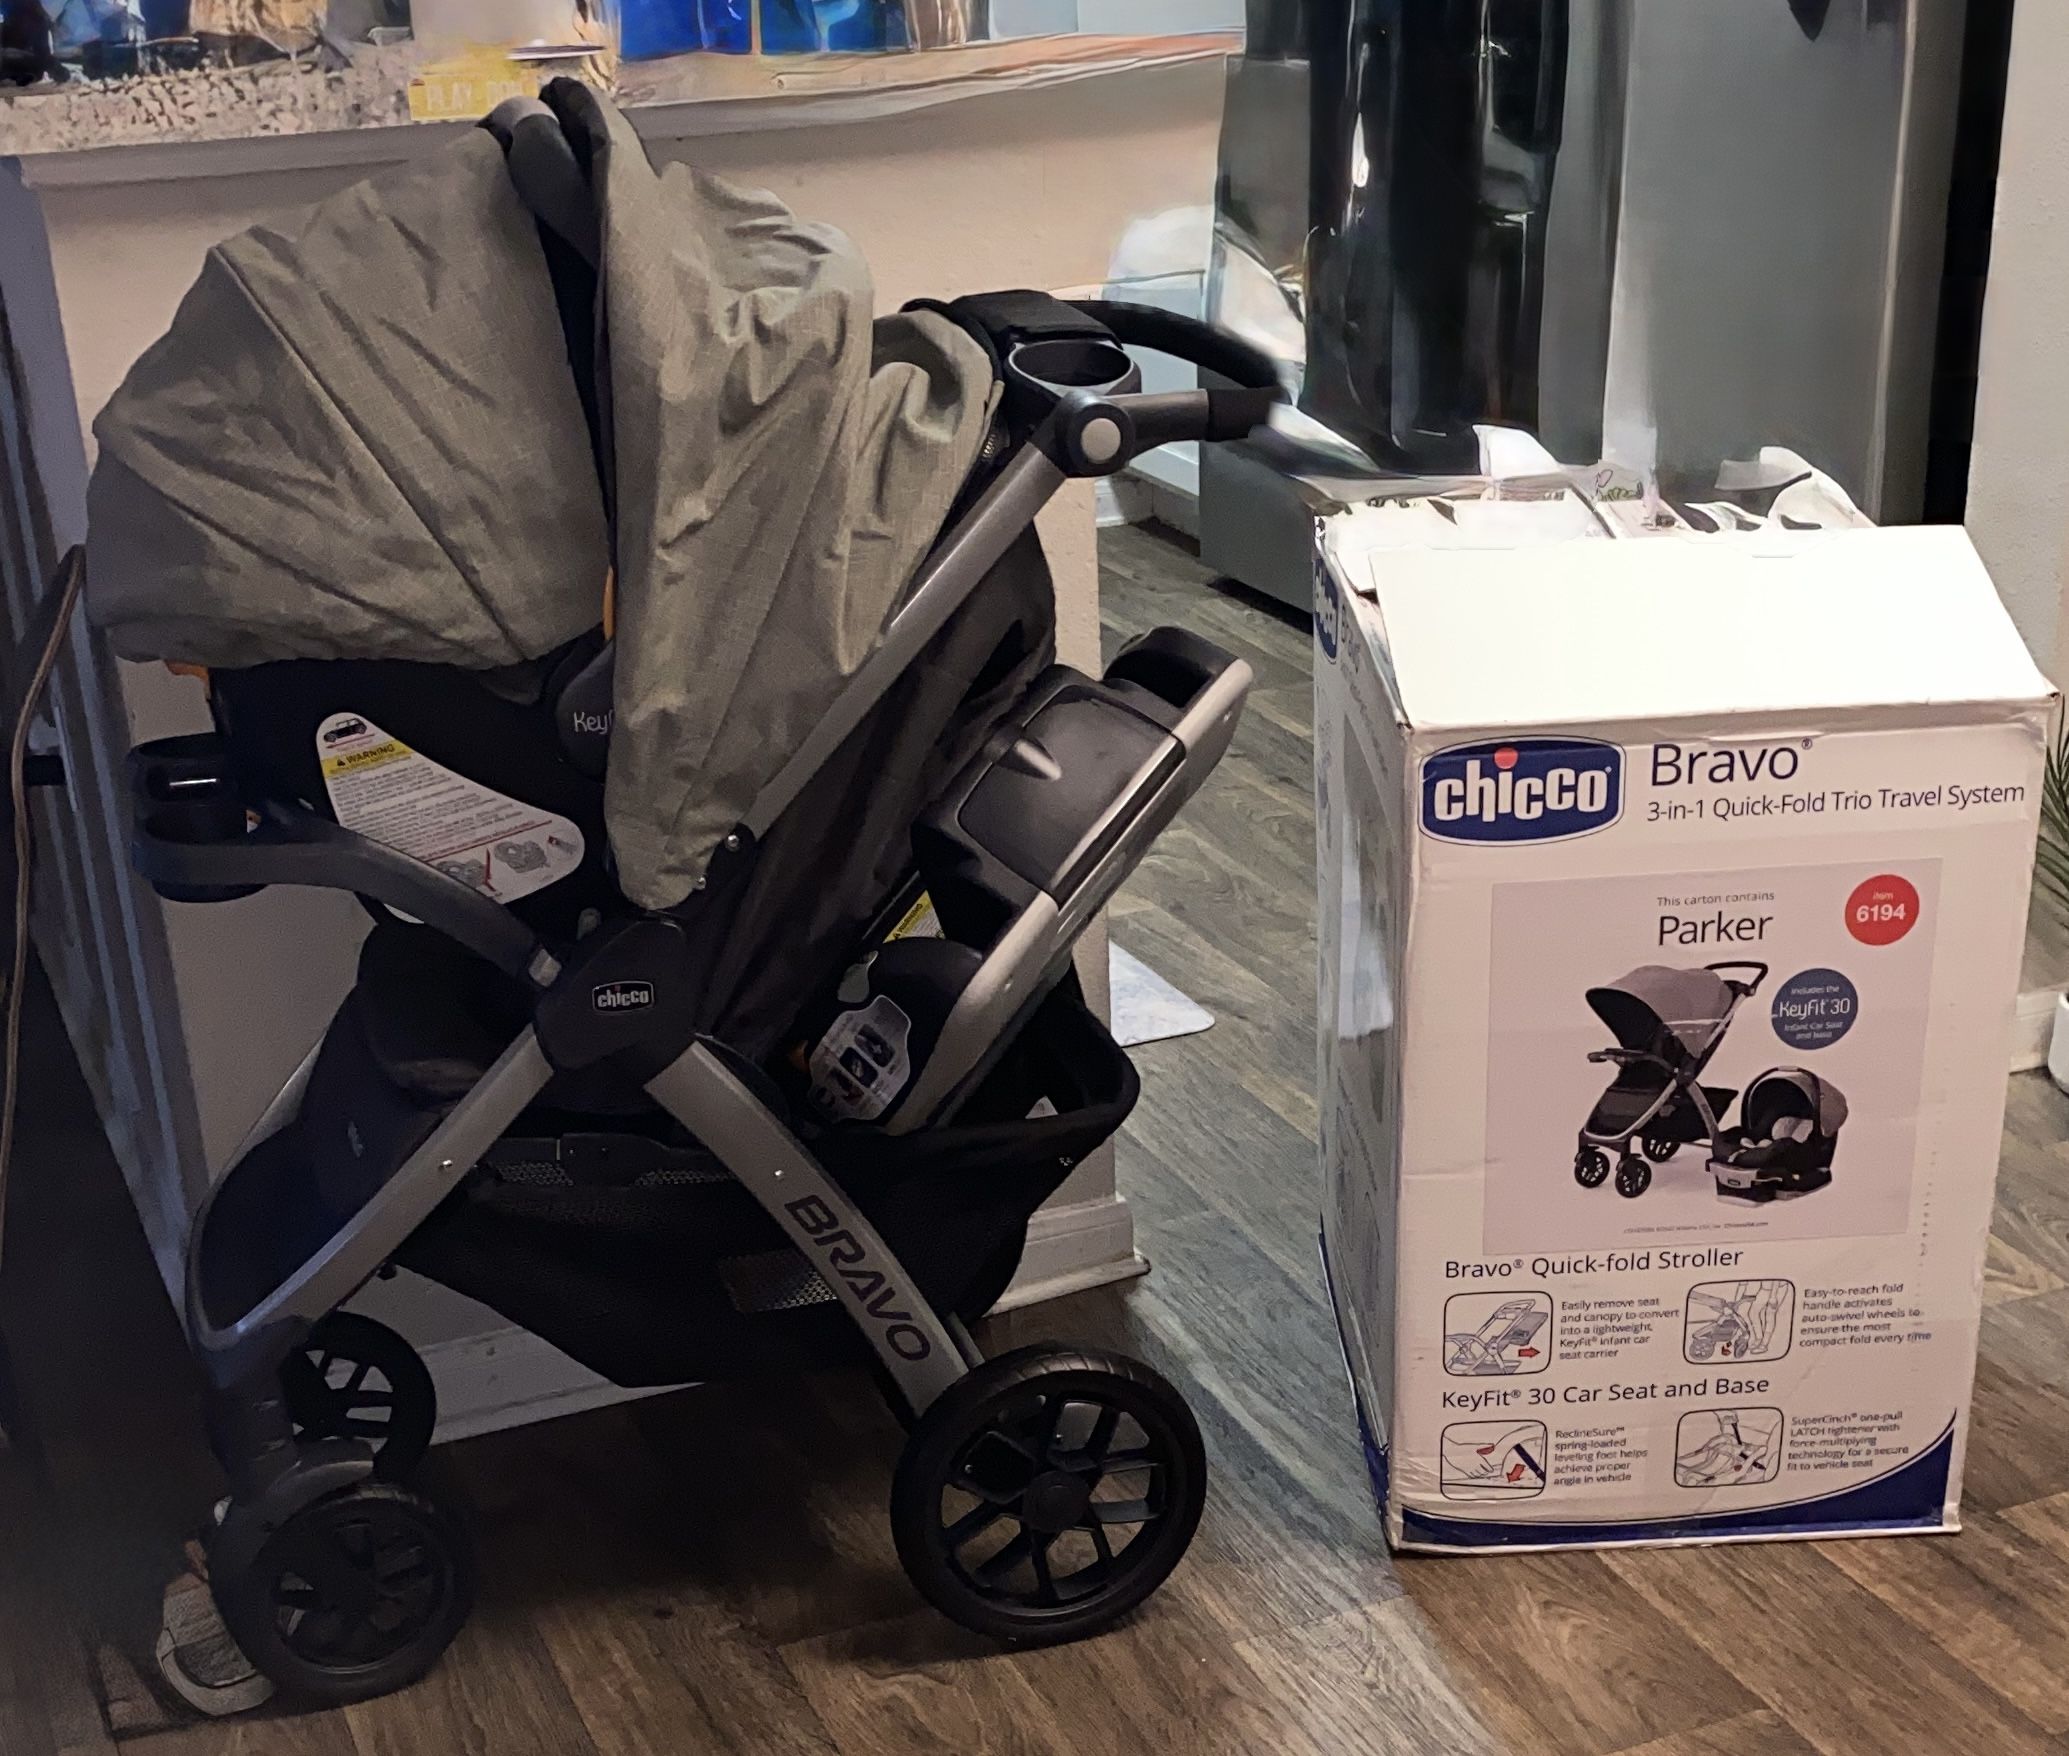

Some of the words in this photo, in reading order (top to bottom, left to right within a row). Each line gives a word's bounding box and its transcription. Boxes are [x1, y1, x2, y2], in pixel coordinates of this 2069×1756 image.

[1434, 747, 1612, 822] chicco
[1647, 801, 1704, 822] 3-in-1
[1713, 792, 1825, 821] Quick-Fold
[1831, 790, 1872, 811] Trio
[1878, 785, 1942, 808] Travel
[1948, 784, 2025, 810] System
[1656, 896, 1680, 907] This
[1684, 894, 1722, 905] carton
[1725, 891, 1776, 902] contains
[1855, 904, 1906, 923] 6194
[1658, 911, 1774, 946] Parker
[597, 984, 649, 1007] chicco
[1830, 997, 1851, 1015] 30
[1531, 1251, 1650, 1278] Quick-fold
[1657, 1247, 1744, 1270] Stroller
[784, 1195, 931, 1361] BRAVO
[1804, 1286, 1880, 1299] Easy-to-reach
[1882, 1283, 1904, 1294] fold
[1561, 1300, 1592, 1312] Easily
[1593, 1299, 1635, 1309] remove
[1638, 1298, 1660, 1308] seat
[1803, 1299, 1842, 1310] handle
[1843, 1297, 1894, 1309] activates
[1560, 1313, 1582, 1323] and
[1584, 1312, 1623, 1323] canopy
[1625, 1310, 1637, 1319] to
[1639, 1309, 1680, 1319] convert
[1866, 1308, 1906, 1319] wheels
[1908, 1308, 1921, 1317] to
[1560, 1326, 1581, 1335] into
[1583, 1326, 1591, 1334] a
[1800, 1324, 1839, 1336] ensure
[1841, 1323, 1860, 1333] the
[1862, 1322, 1892, 1332] most
[1633, 1334, 1651, 1345] car
[1799, 1336, 1847, 1348] compact
[1849, 1334, 1872, 1345] fold
[1874, 1333, 1905, 1345] every
[1906, 1331, 1932, 1342] time
[1559, 1350, 1581, 1360] seat
[1583, 1348, 1620, 1358] carrier
[1528, 1386, 1556, 1405] 30
[1563, 1386, 1603, 1404] Car
[1608, 1383, 1658, 1401] Seat
[1664, 1379, 1708, 1398] and
[1715, 1378, 1770, 1395] Base
[1859, 1410, 1903, 1423] one-pull
[1790, 1427, 1826, 1438] LATCH
[1876, 1423, 1901, 1433] with
[1554, 1438, 1628, 1452] spring-loaded
[1554, 1451, 1594, 1463] leveling
[1619, 1448, 1649, 1459] helps
[1787, 1448, 1845, 1460] technology
[1847, 1446, 1863, 1457] for
[1865, 1448, 1873, 1456] a
[1553, 1463, 1593, 1474] achieve
[1595, 1462, 1631, 1473] proper
[1786, 1462, 1798, 1472] fit
[1799, 1461, 1811, 1471] to
[1812, 1460, 1849, 1471] vehicle
[1553, 1475, 1582, 1486] angle
[1583, 1475, 1594, 1484] in
[1596, 1472, 1633, 1483] vehicle
